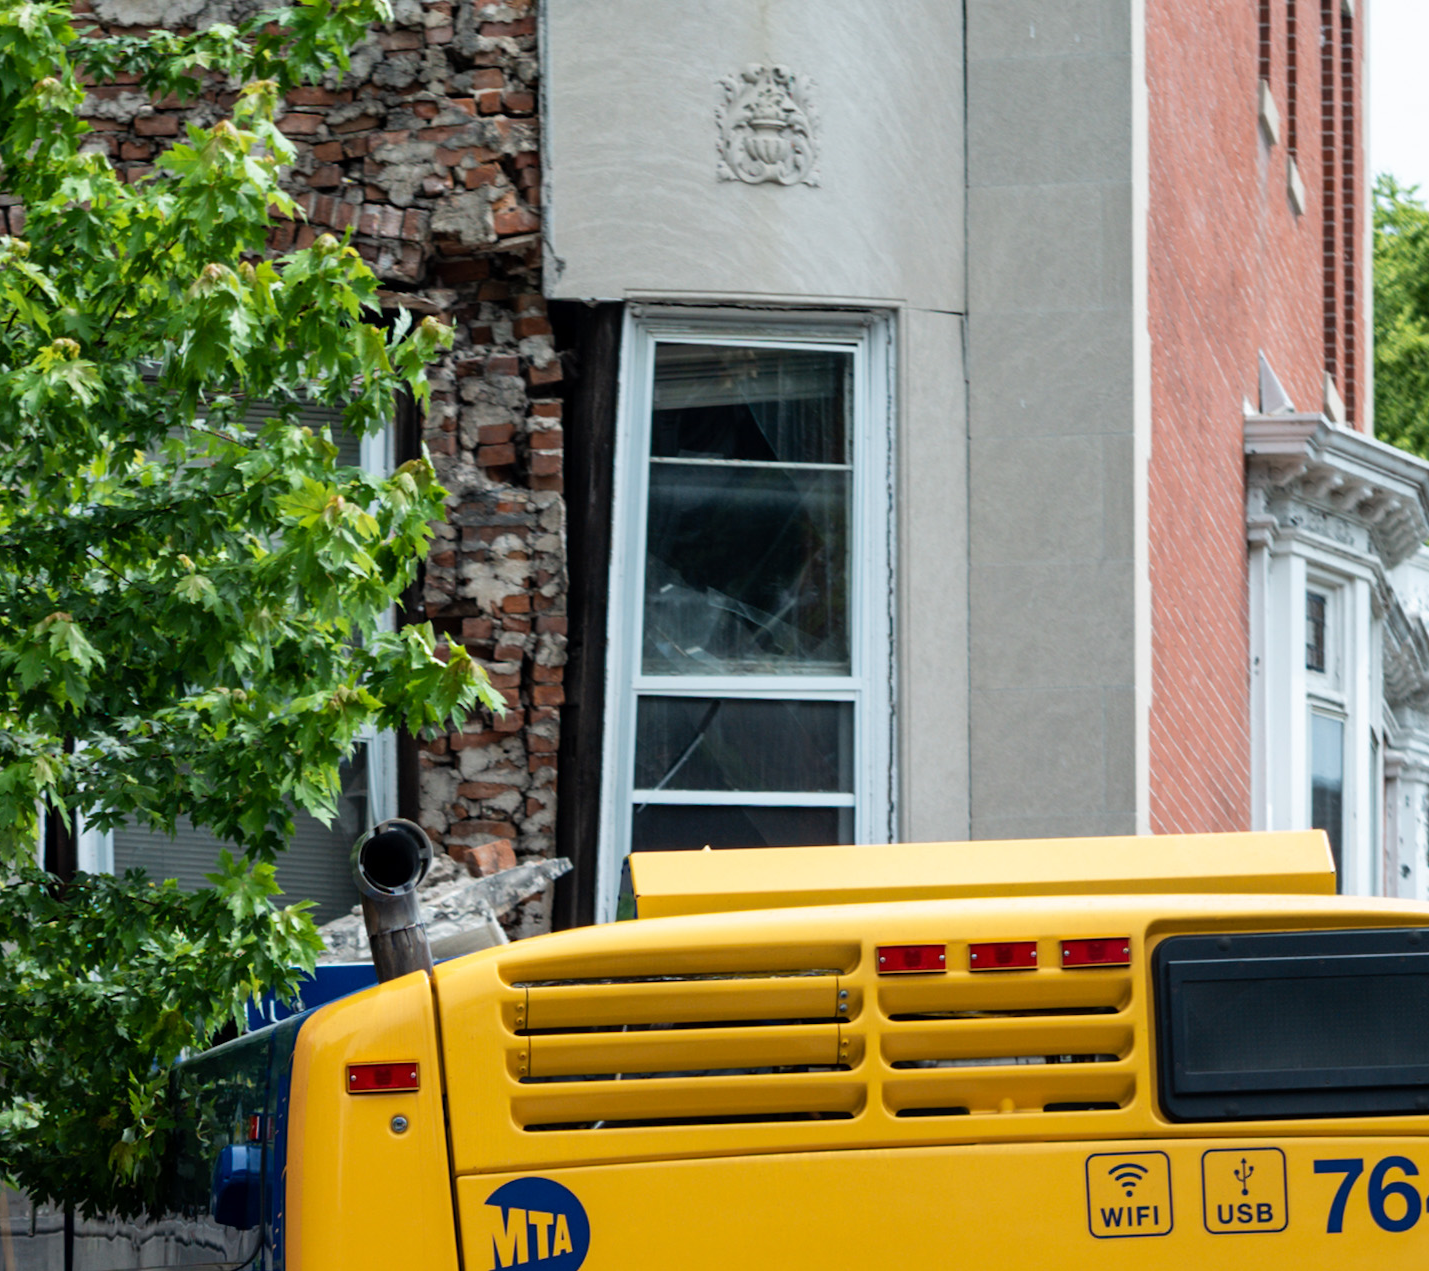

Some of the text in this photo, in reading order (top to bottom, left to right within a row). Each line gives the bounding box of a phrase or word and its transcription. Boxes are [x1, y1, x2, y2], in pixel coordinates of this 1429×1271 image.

[1101, 1206, 1159, 1228] WIFI
[1217, 1203, 1274, 1224] USB
[481, 1203, 573, 1270] MTA
